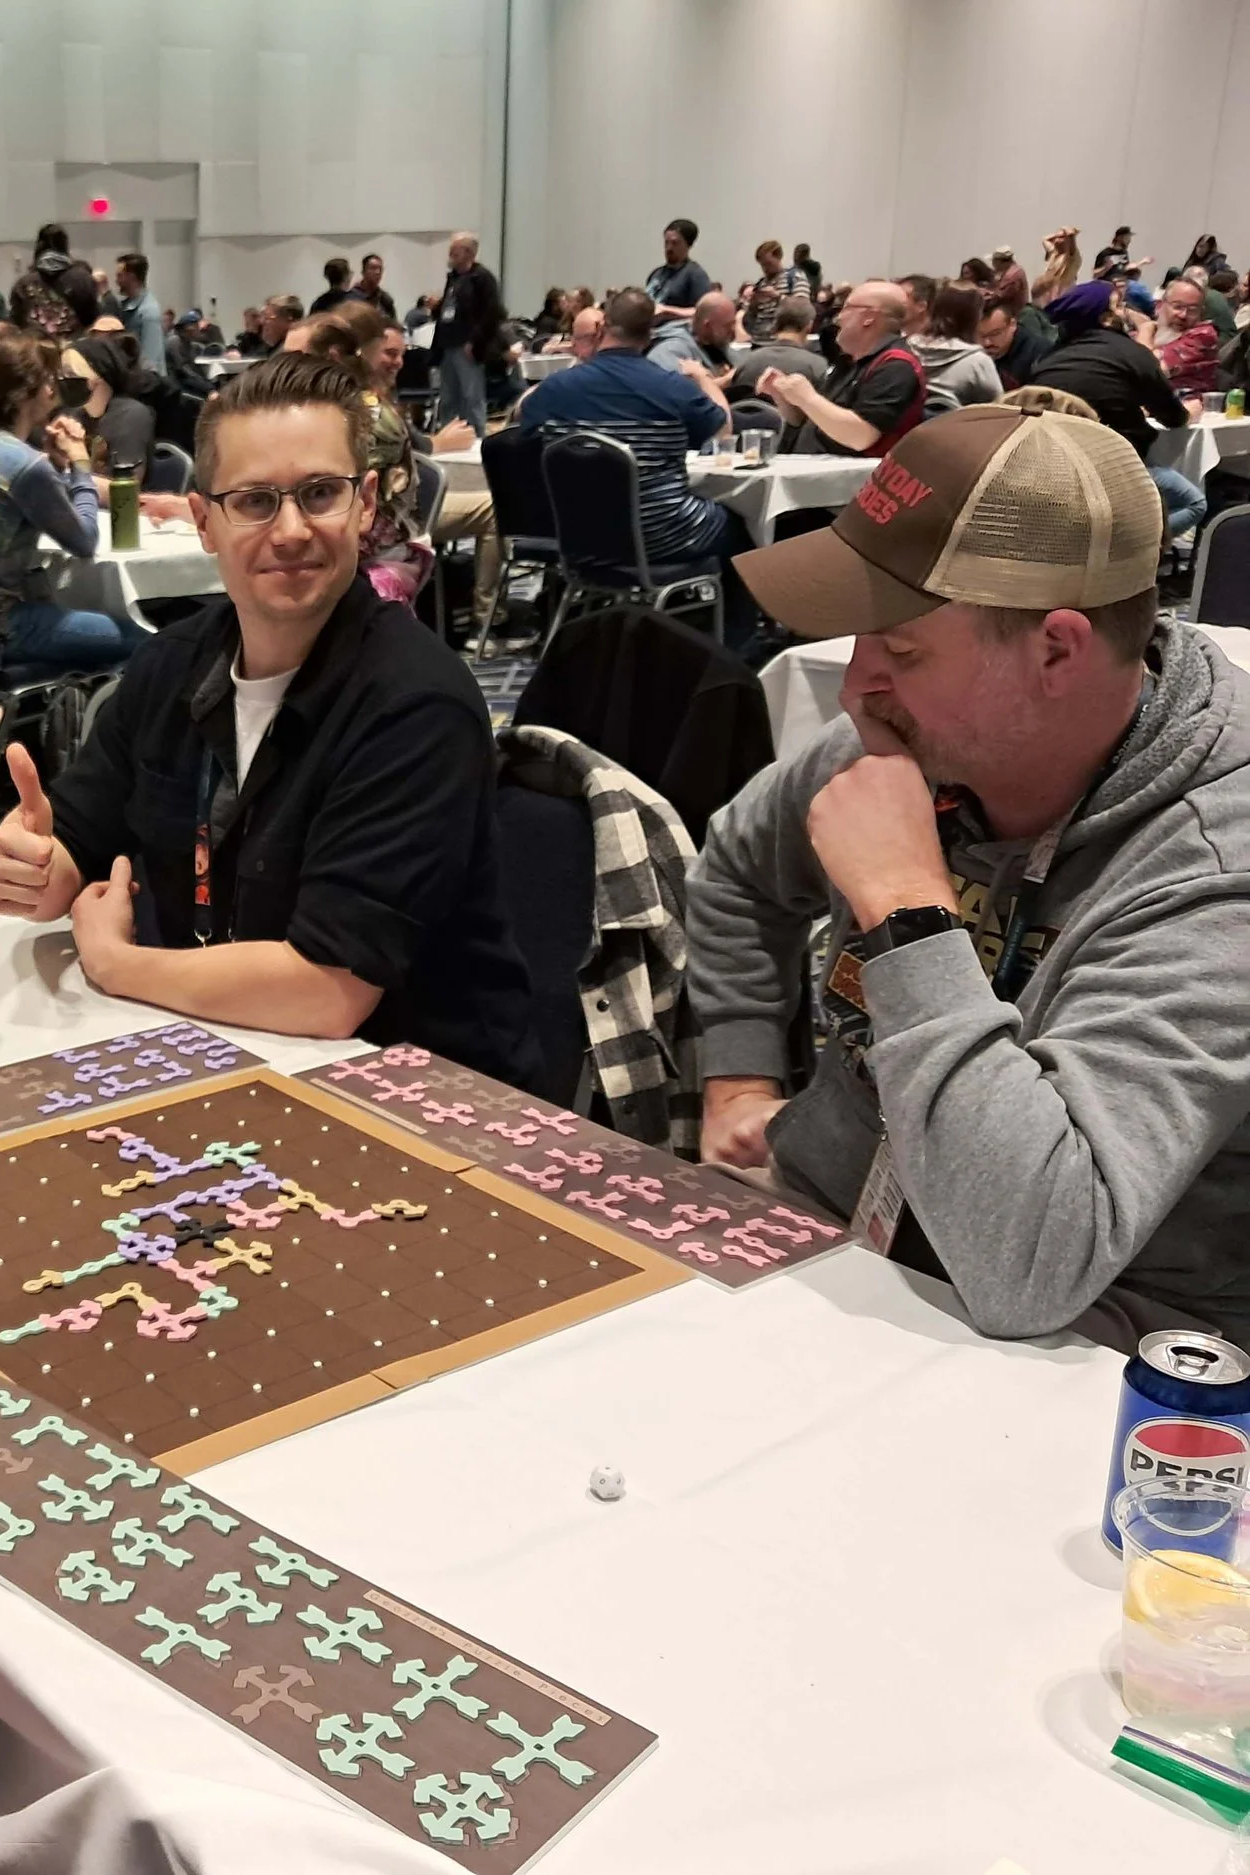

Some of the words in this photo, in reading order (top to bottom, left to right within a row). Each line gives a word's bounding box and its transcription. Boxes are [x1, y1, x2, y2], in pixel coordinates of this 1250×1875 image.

[857, 479, 899, 524] OES
[1130, 1447, 1244, 1493] PEPSI
[462, 1641, 522, 1677] Puzzle
